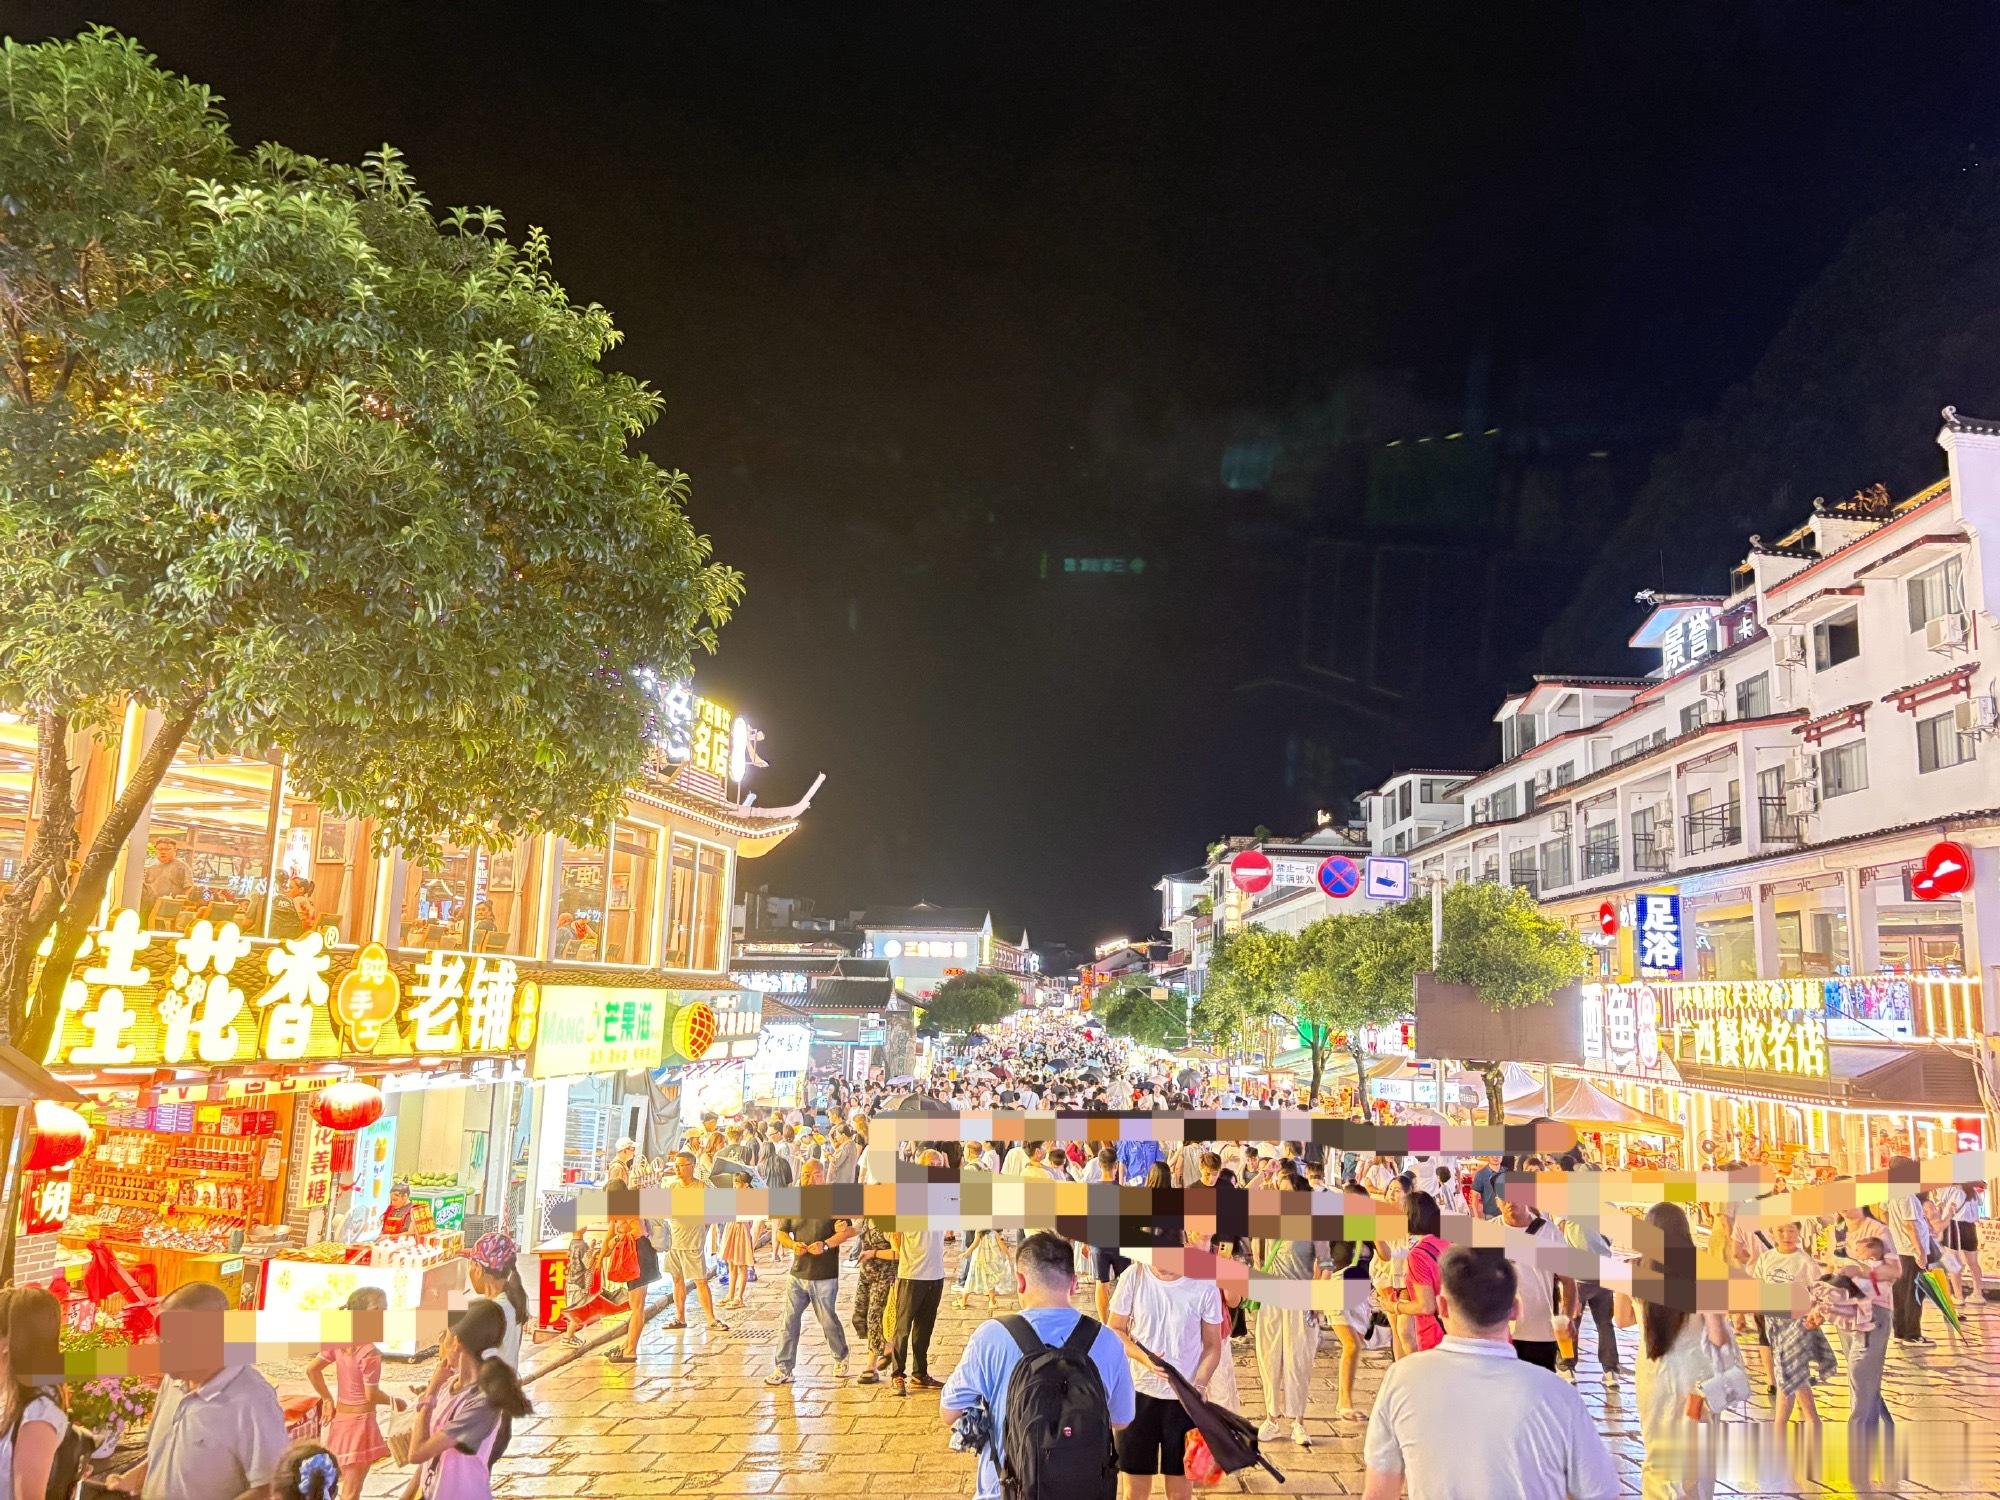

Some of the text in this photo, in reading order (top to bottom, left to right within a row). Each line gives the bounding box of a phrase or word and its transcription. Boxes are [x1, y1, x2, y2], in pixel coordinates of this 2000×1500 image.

[1275, 863, 1315, 876] 禁止一切
[1275, 874, 1315, 885] 车辆驶入
[1642, 897, 1679, 967] 足浴
[408, 950, 518, 1052] 老铺
[1674, 1016, 1826, 1077] 广西餐饮名店
